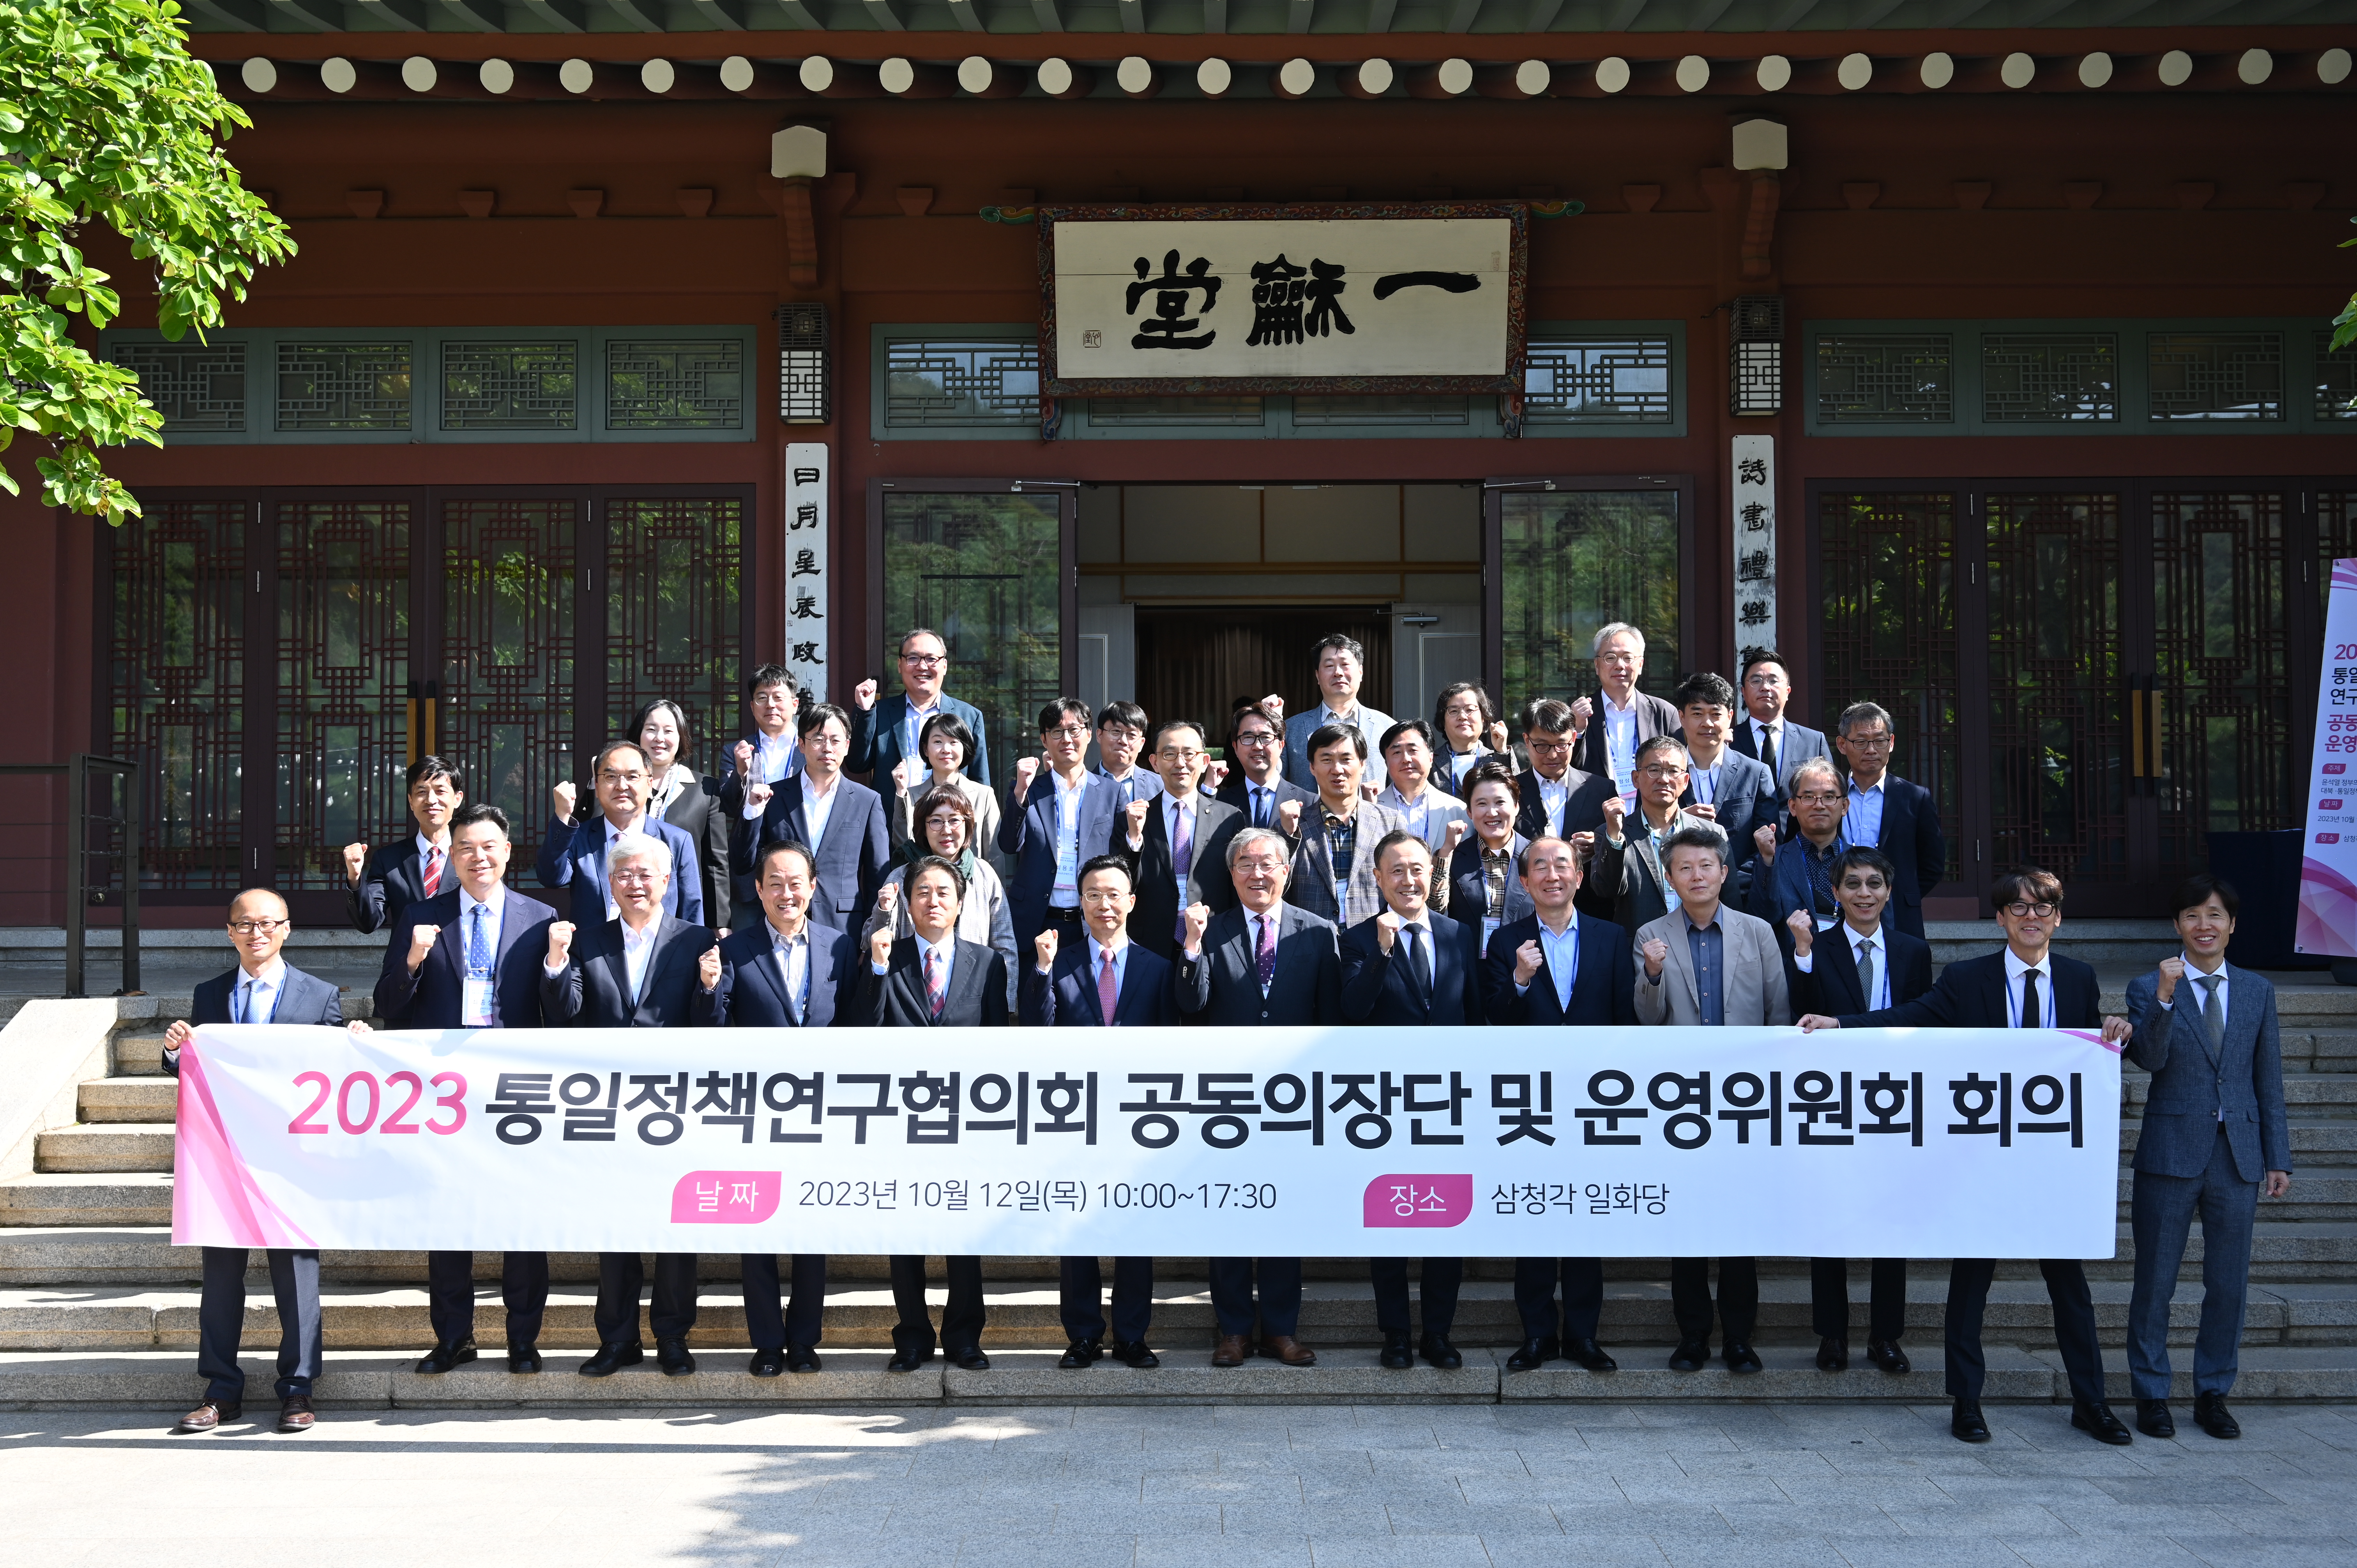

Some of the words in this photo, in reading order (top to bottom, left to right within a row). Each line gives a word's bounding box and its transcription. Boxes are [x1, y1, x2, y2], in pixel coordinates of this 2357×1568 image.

[289, 1071, 467, 1135] 2023
[486, 1070, 1097, 1146] 통일정책연구협의회
[1119, 1071, 1472, 1150] 공동의장단
[1491, 1071, 1556, 1146] 및
[1574, 1070, 1923, 1150] 운영위원회
[1947, 1072, 2083, 1148] 회의
[799, 1180, 897, 1209] 2023년
[909, 1180, 968, 1210] 10월
[980, 1180, 1087, 1212] 12일(목)
[1098, 1183, 1277, 1209] 10:00~17:30
[1389, 1184, 1447, 1216] 장소
[1491, 1183, 1577, 1215] 삼청각
[1585, 1183, 1670, 1215] 일화당
